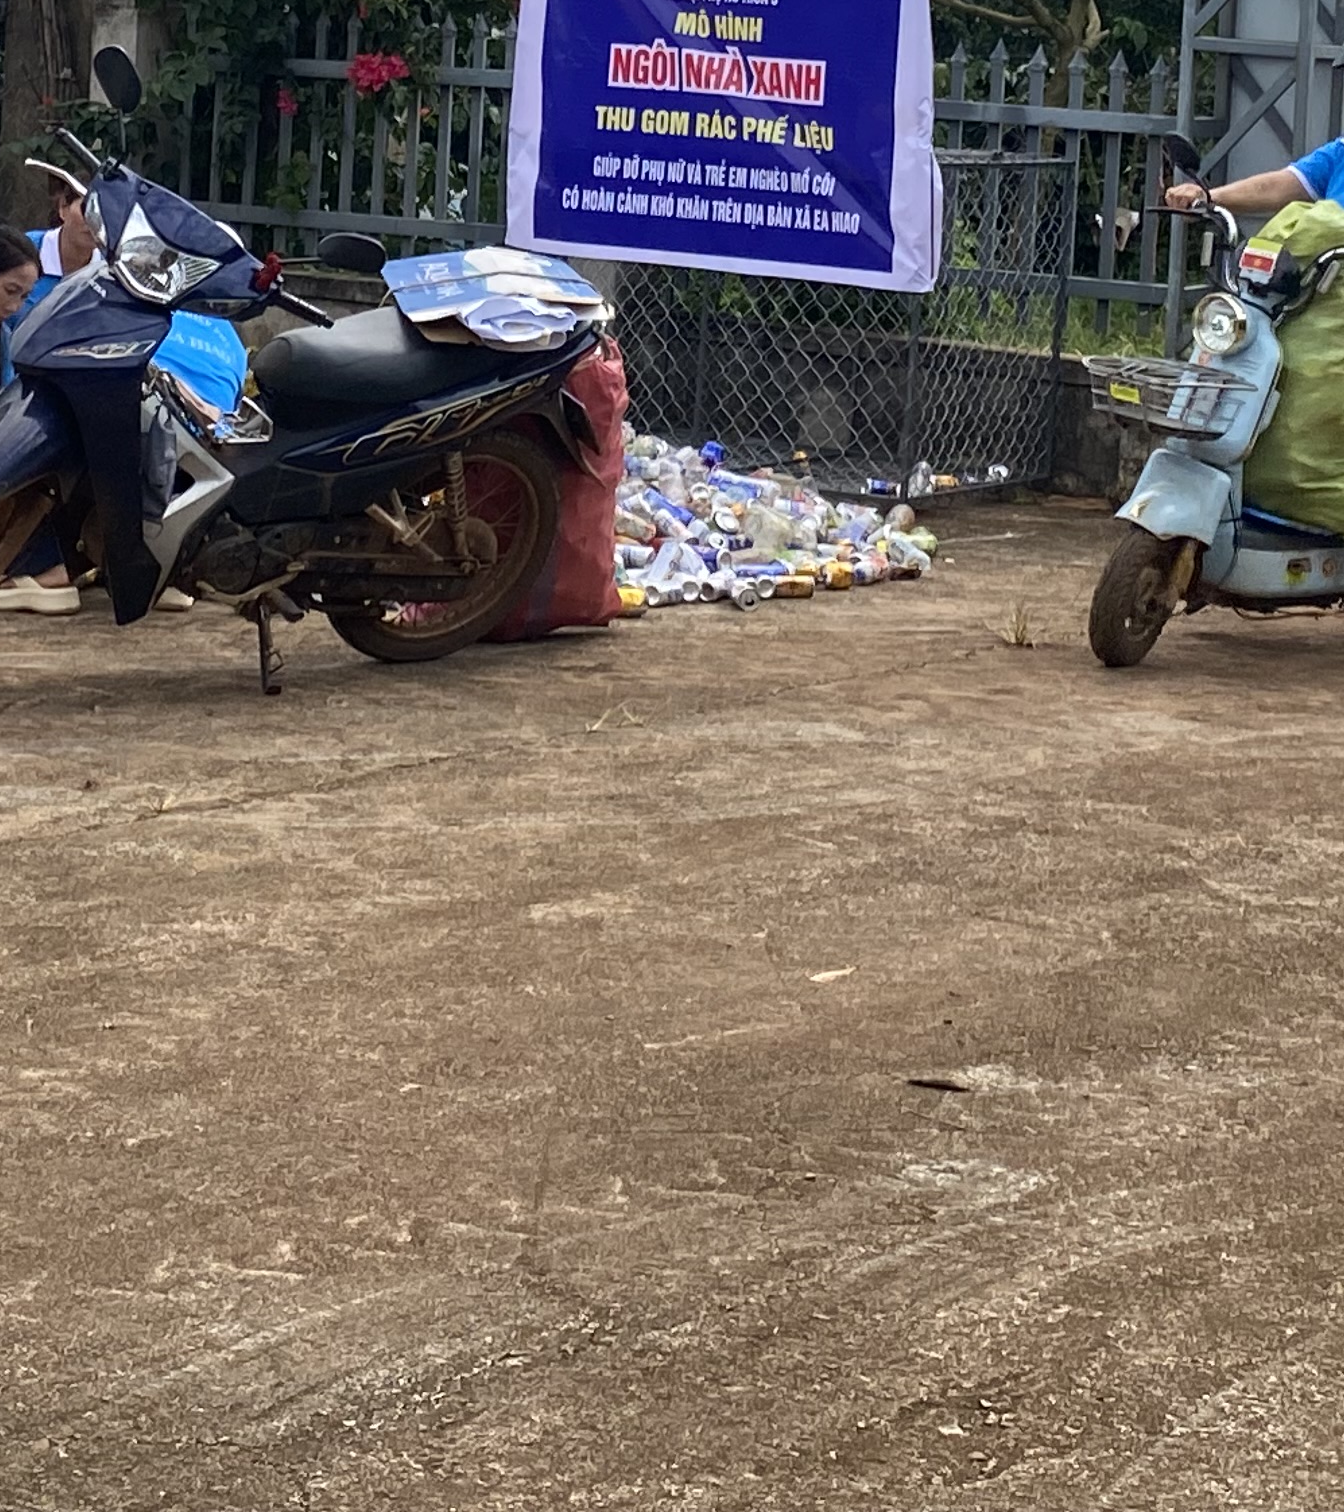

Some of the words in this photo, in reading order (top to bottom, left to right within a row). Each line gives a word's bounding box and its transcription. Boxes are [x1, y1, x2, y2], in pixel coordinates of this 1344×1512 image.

[673, 9, 711, 38] MÔ
[714, 10, 763, 43] HÌNH
[611, 41, 677, 88] NGÔI
[683, 47, 745, 95] NHÀ
[751, 57, 824, 103] XANH
[595, 105, 635, 131] THU
[641, 107, 690, 137] GOM
[695, 109, 737, 140] RÁC
[742, 114, 789, 146] PHẾ
[793, 120, 834, 155] LIỆU
[593, 152, 621, 178] GIÚP
[641, 159, 666, 186] PHỤ
[667, 158, 686, 183] NỮ
[687, 159, 702, 185] VÀ
[728, 166, 748, 189] EM
[749, 165, 788, 193] NGHÈO
[811, 171, 836, 197] CÔI
[562, 184, 579, 209] CÓ
[581, 186, 615, 213] HOÀN
[617, 186, 649, 215] CẢNH
[650, 192, 674, 217] KHÓ
[676, 194, 709, 221] KHĂN
[712, 196, 742, 223] TRÊN
[767, 201, 792, 228] BÀN
[794, 204, 811, 230] XÃ
[813, 209, 829, 232] EA
[831, 210, 860, 235] HIAO
